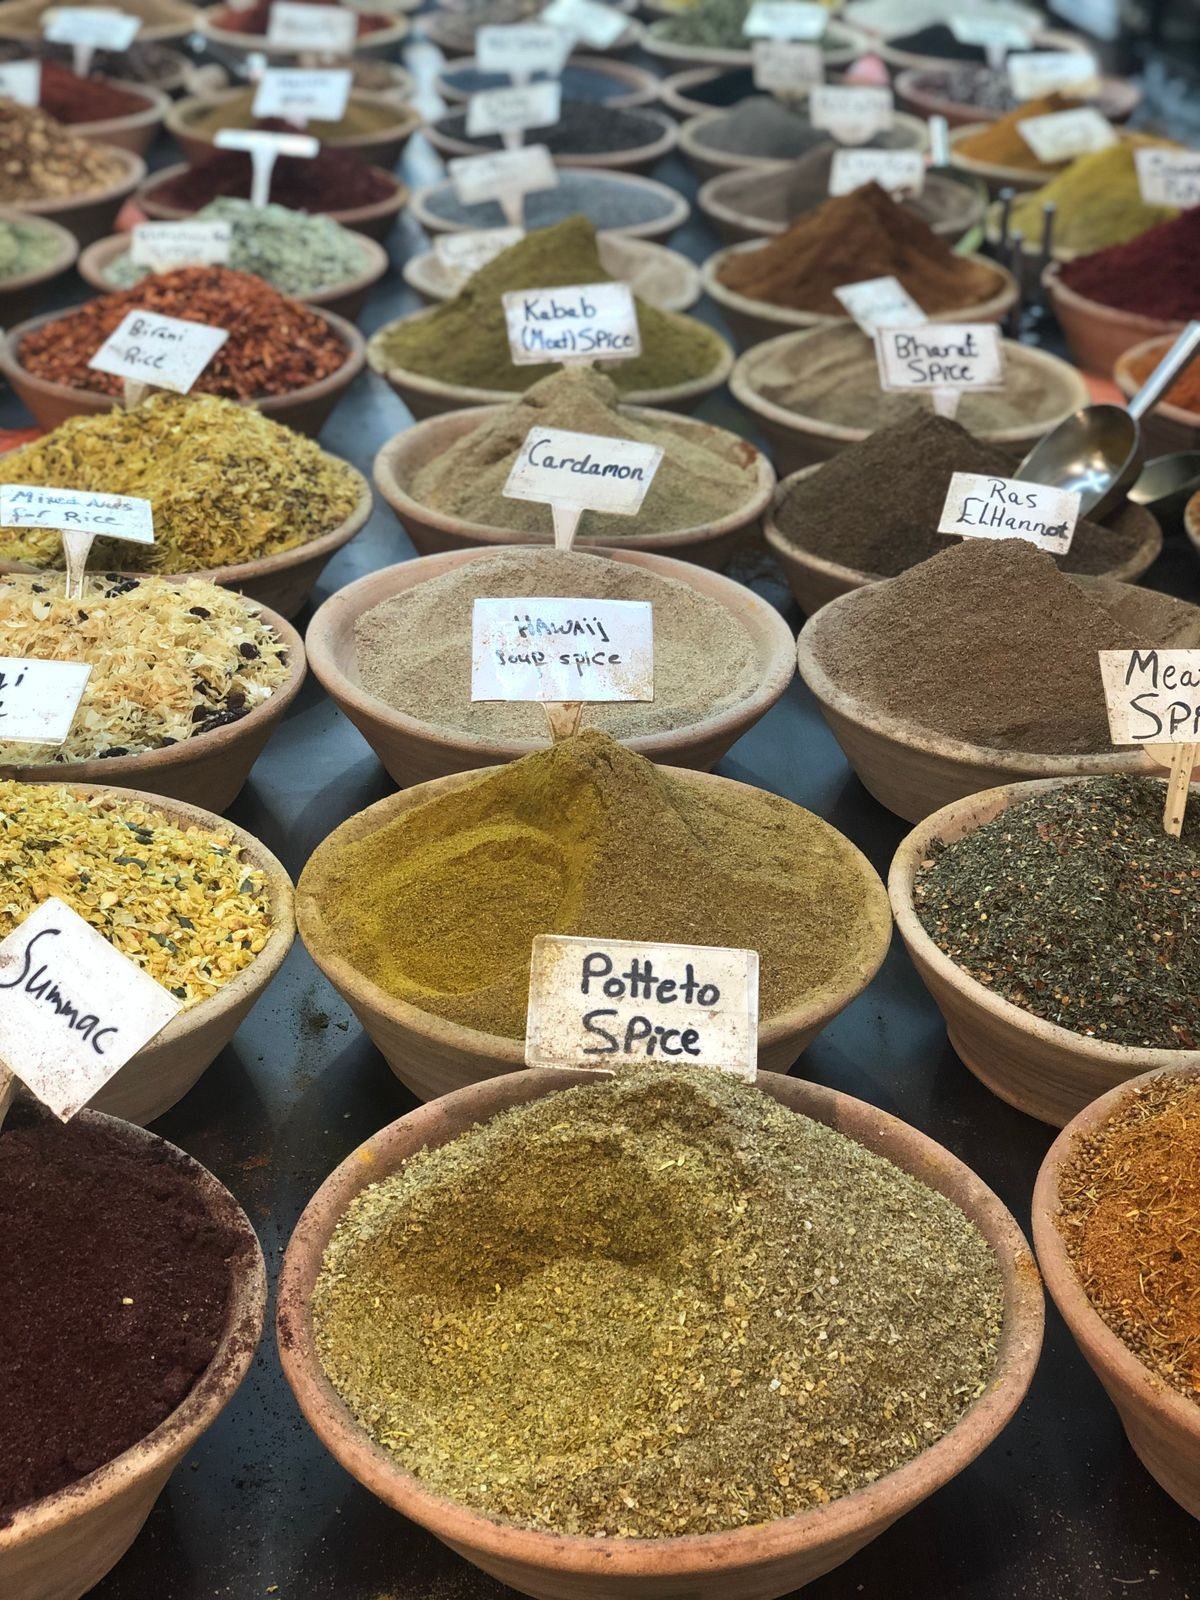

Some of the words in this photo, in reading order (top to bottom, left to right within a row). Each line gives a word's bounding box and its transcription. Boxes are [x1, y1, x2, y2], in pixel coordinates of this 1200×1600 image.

[528, 439, 644, 481] Cardamon
[988, 478, 1038, 509] Ras
[1125, 650, 1200, 690] Mea
[580, 952, 721, 1006] Potteto
